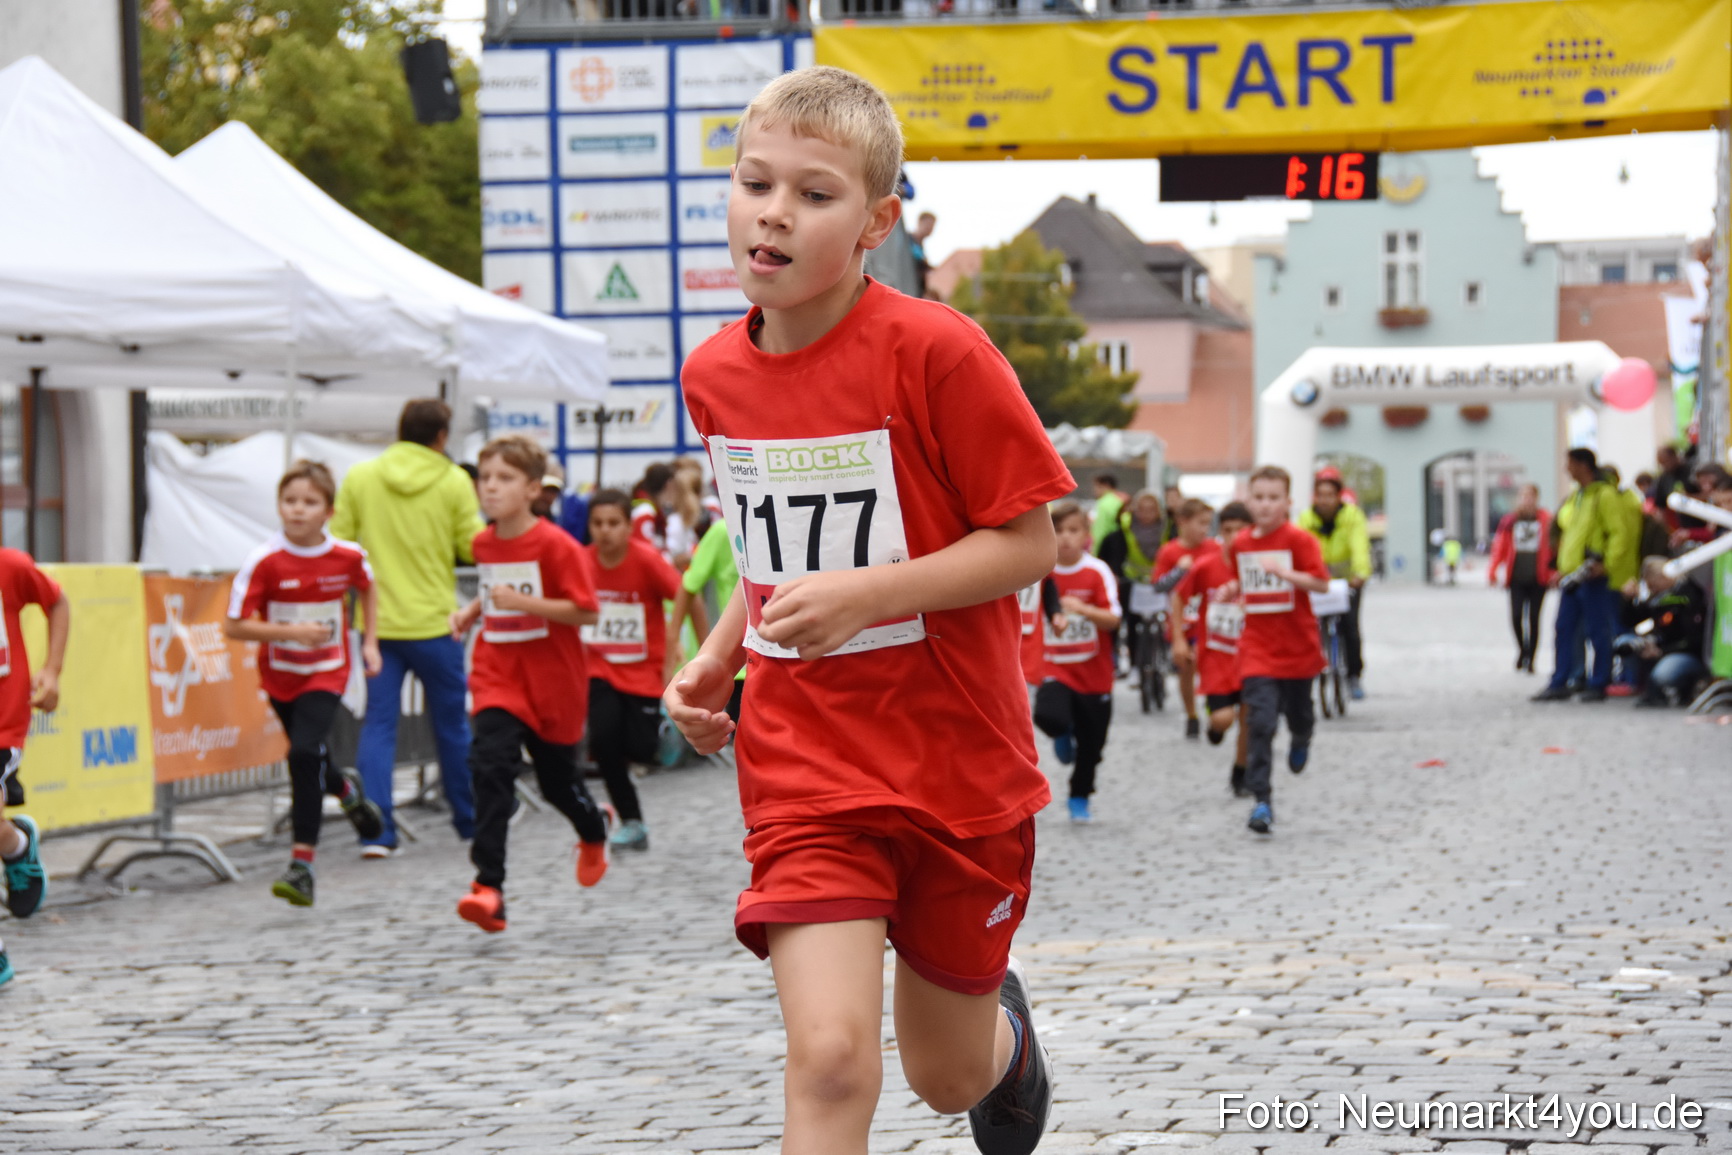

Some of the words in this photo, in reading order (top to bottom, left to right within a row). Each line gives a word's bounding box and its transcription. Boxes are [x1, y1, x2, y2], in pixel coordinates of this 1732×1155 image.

[1108, 35, 1414, 115] START
[1330, 363, 1414, 388] BMW
[1423, 361, 1575, 392] Laufsport
[767, 441, 869, 472] BOCK
[768, 475, 798, 484] inspired
[798, 474, 809, 483] by
[810, 473, 834, 481] smart
[836, 467, 876, 478] concepts
[735, 488, 878, 572] 7177
